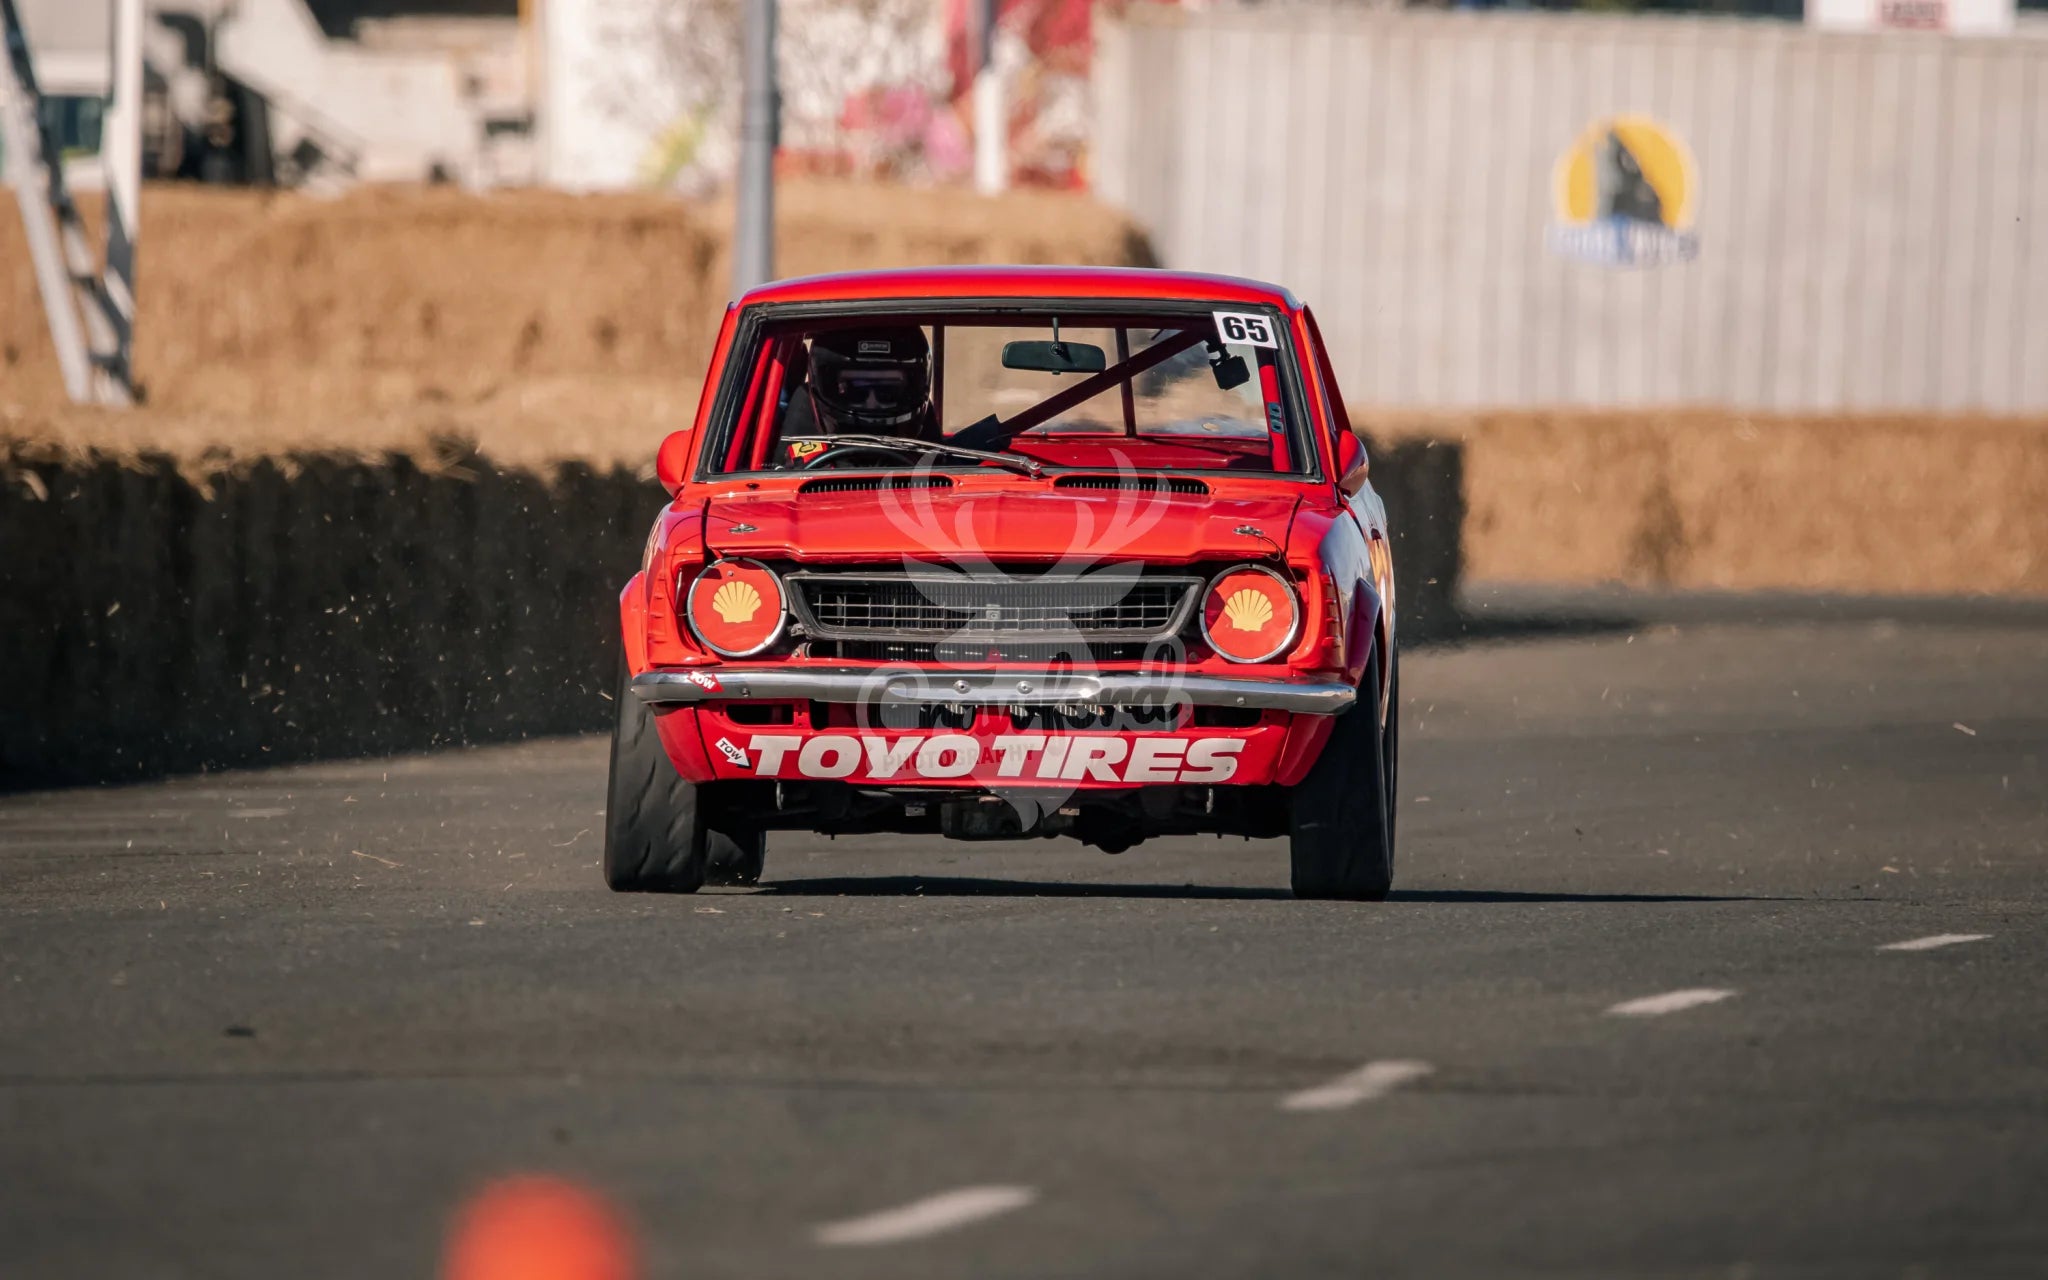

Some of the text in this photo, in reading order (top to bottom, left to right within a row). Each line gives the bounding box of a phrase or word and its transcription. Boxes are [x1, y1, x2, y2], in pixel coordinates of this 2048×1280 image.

[1222, 316, 1269, 343] 65
[689, 671, 715, 690] TOW
[719, 740, 743, 761] TOW
[748, 733, 1246, 783] TOYO TIRES
